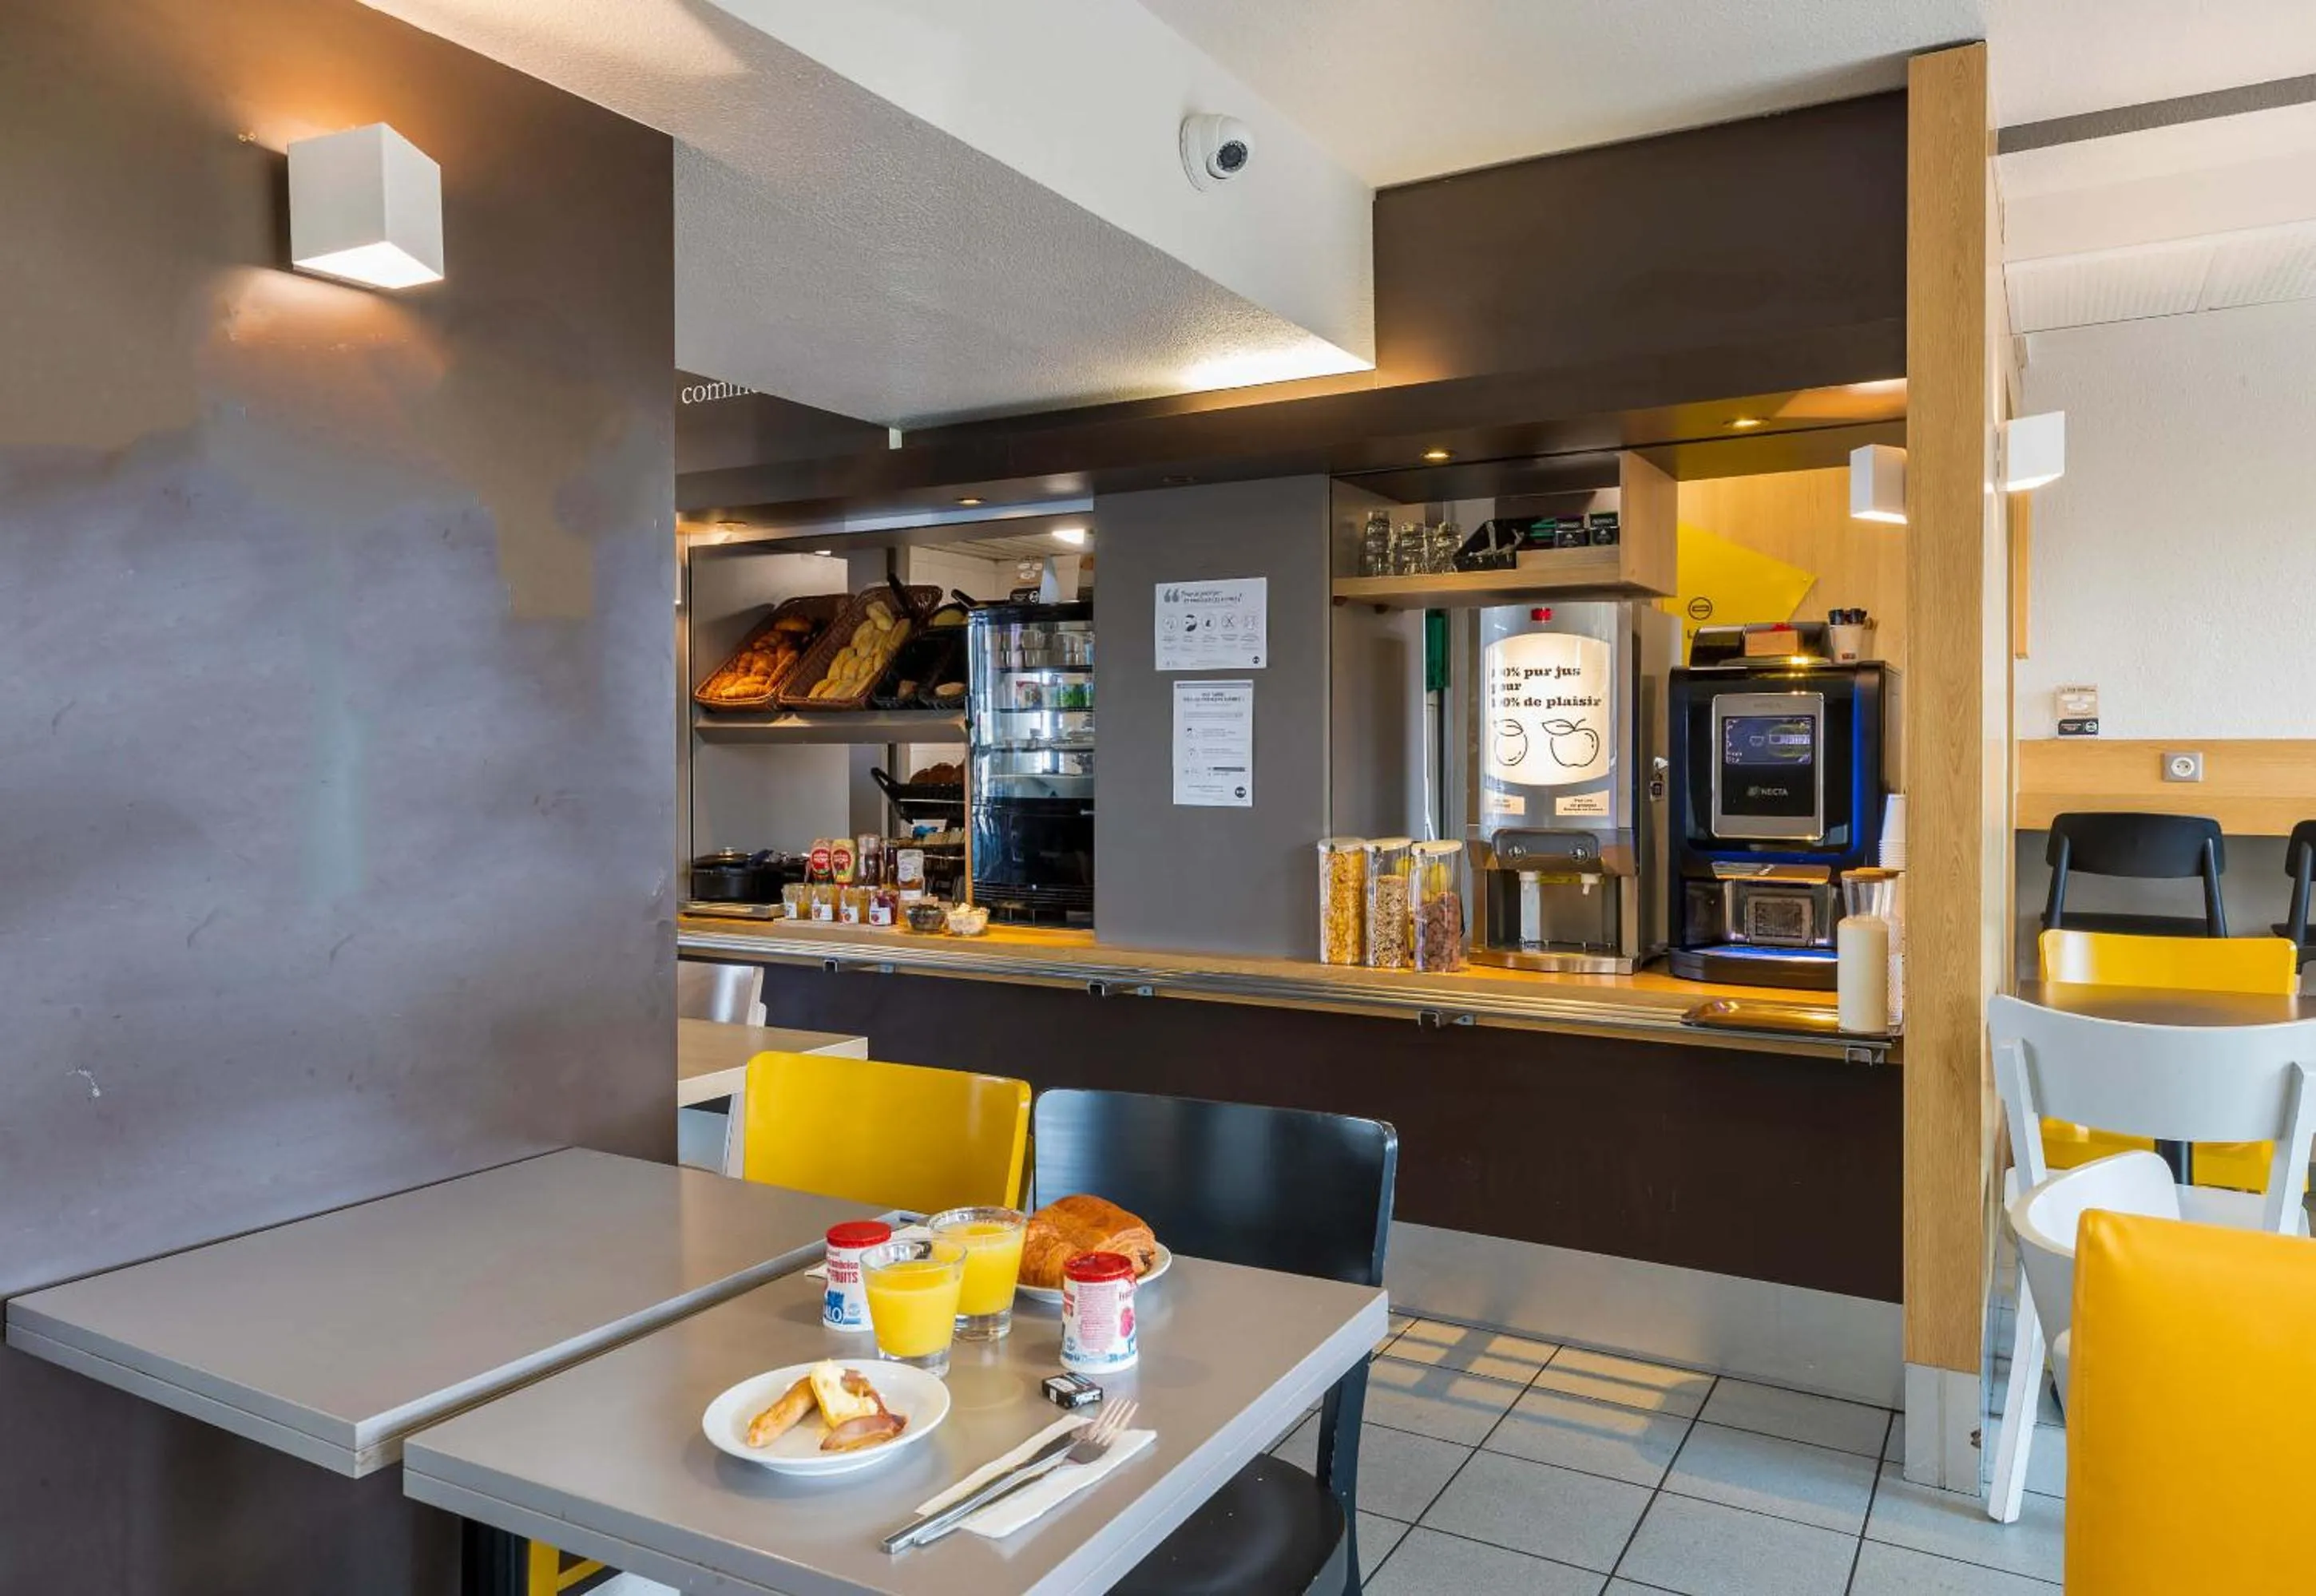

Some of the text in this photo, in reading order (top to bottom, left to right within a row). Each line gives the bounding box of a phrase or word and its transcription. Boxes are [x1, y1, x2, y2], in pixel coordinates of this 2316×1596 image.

[681, 382, 759, 404] comm
[1523, 667, 1552, 679] pur
[1554, 664, 1581, 679] jus
[1523, 696, 1542, 707] de
[1545, 695, 1601, 709] plaisir
